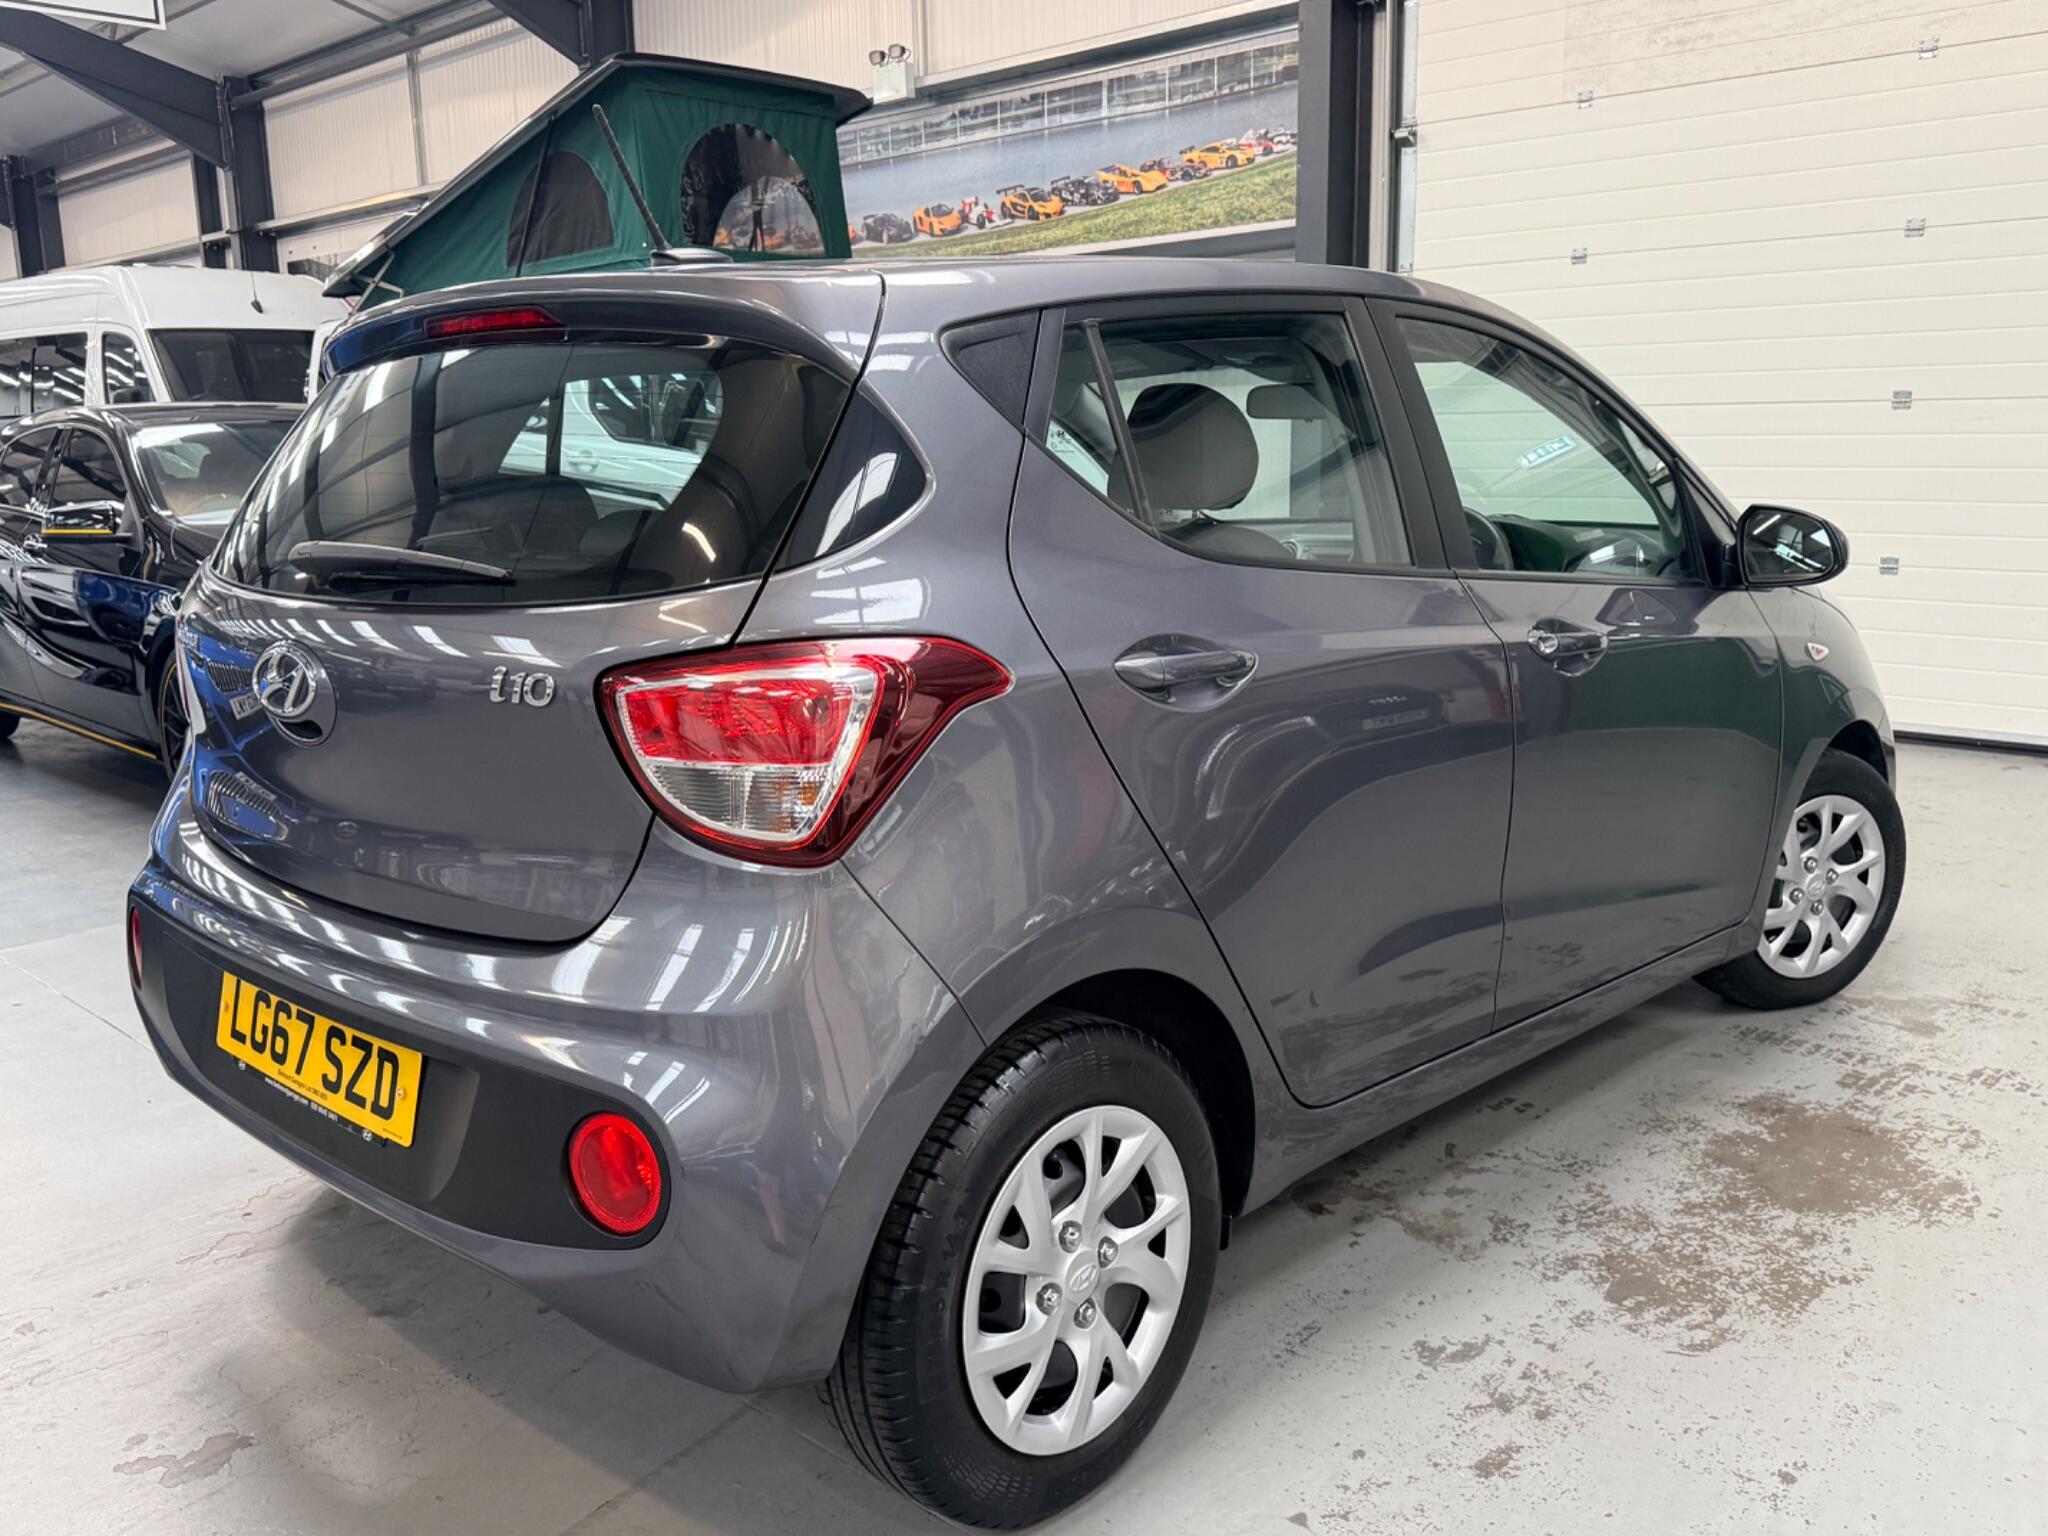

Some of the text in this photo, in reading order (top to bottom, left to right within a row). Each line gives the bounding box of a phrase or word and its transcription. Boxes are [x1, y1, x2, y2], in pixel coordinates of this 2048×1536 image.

[490, 665, 554, 707] i10
[230, 978, 315, 1076] LG67
[321, 1024, 400, 1121] SZD
